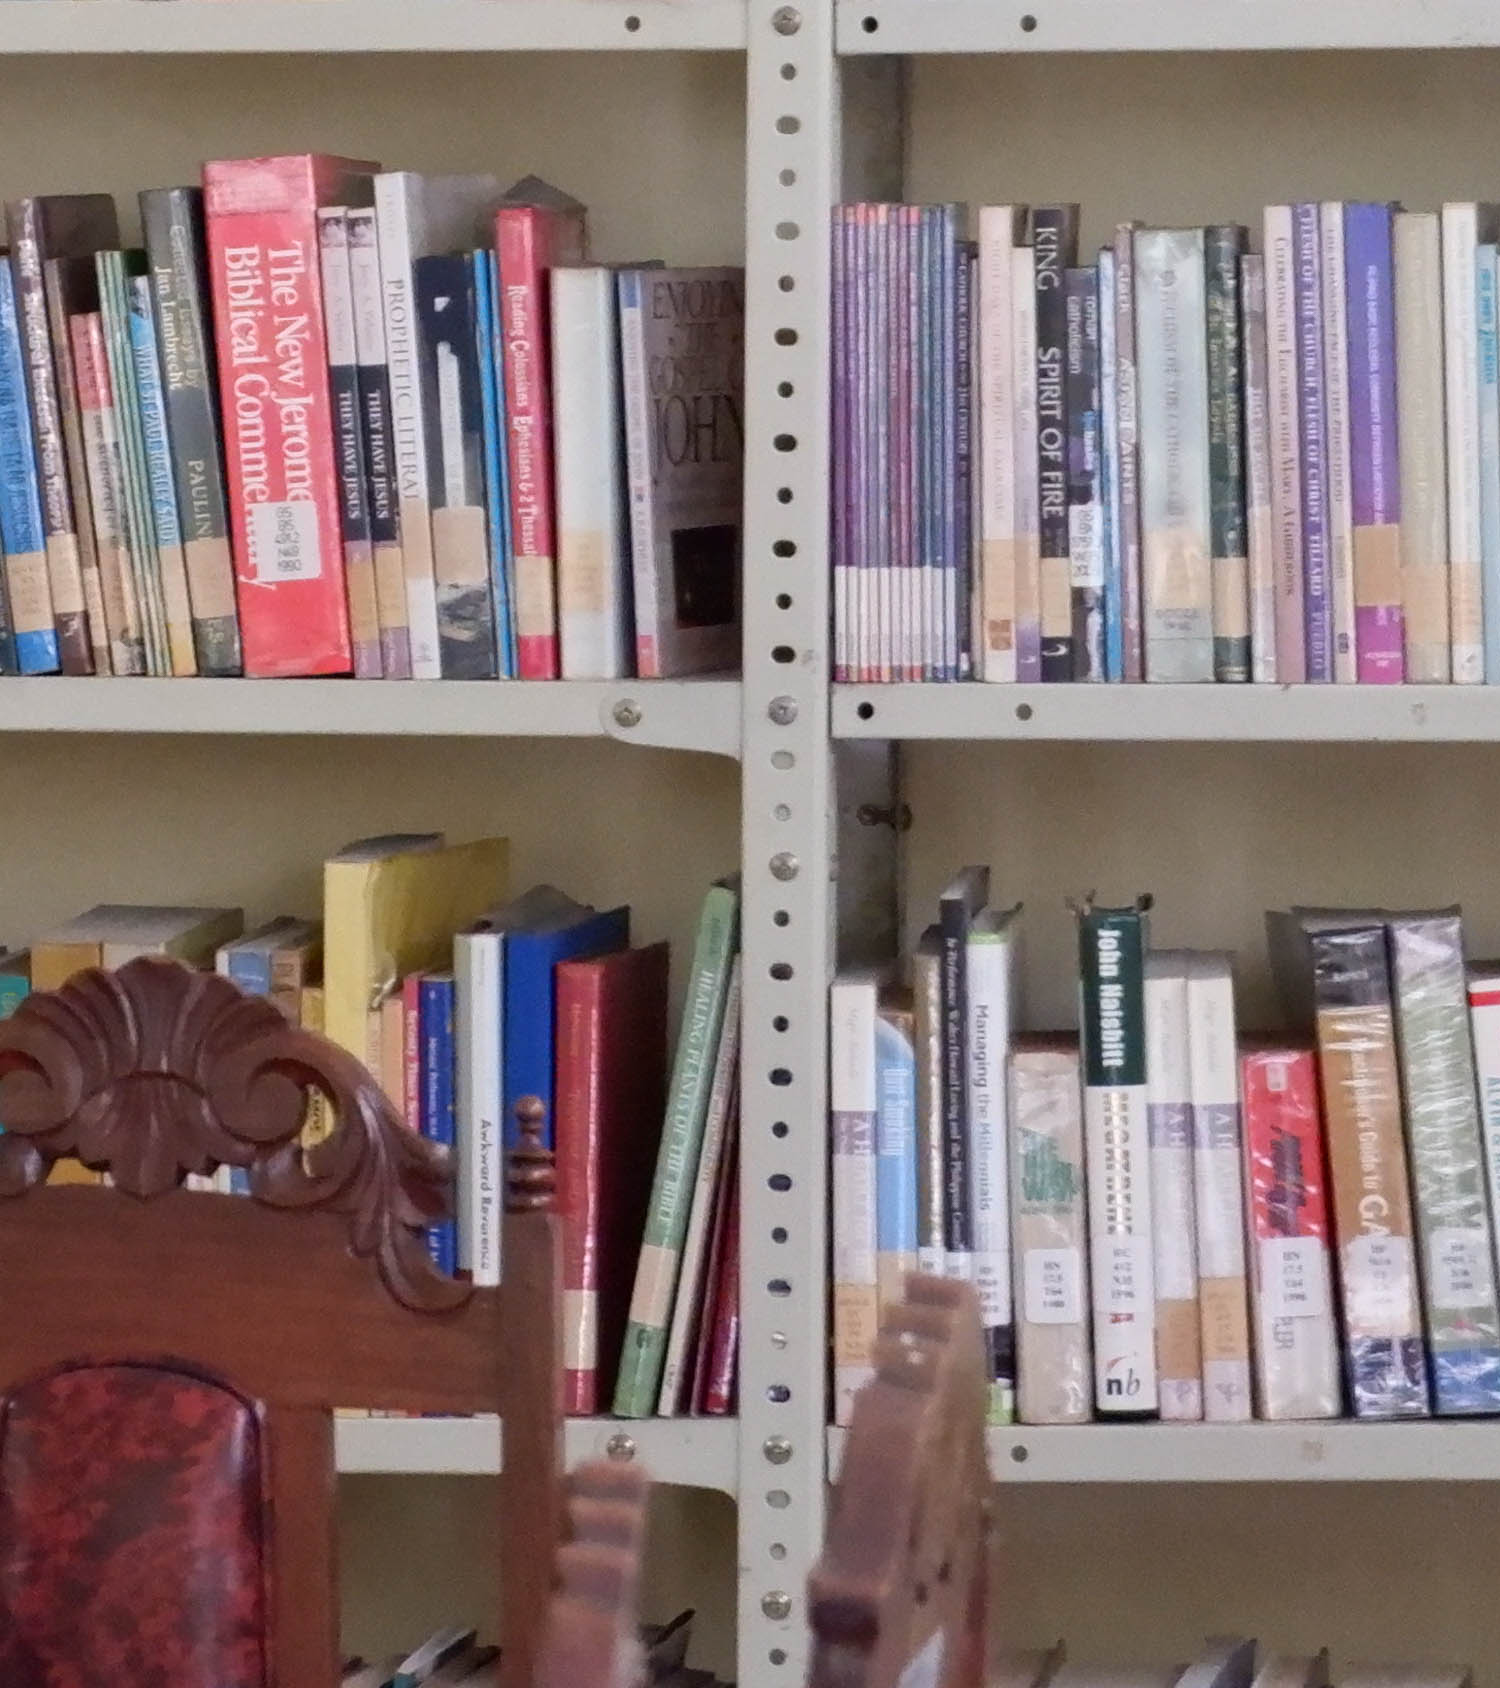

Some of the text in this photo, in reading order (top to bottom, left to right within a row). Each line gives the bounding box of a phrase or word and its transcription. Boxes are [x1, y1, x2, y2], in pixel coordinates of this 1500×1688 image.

[153, 263, 186, 392] Jan Lambrecht
[222, 244, 267, 367] Biblical
[267, 240, 311, 393] The New
[385, 277, 413, 411] PROPHETIC
[1034, 225, 1065, 521] KING SPIRIT OF FIRE
[337, 389, 362, 520] THEY HAVE JESUS
[366, 387, 391, 520] THEY HAVE JESUS
[971, 1002, 992, 1090] Managing
[1096, 929, 1128, 1068] John Naisbitt
[479, 1118, 495, 1193] Awkward
